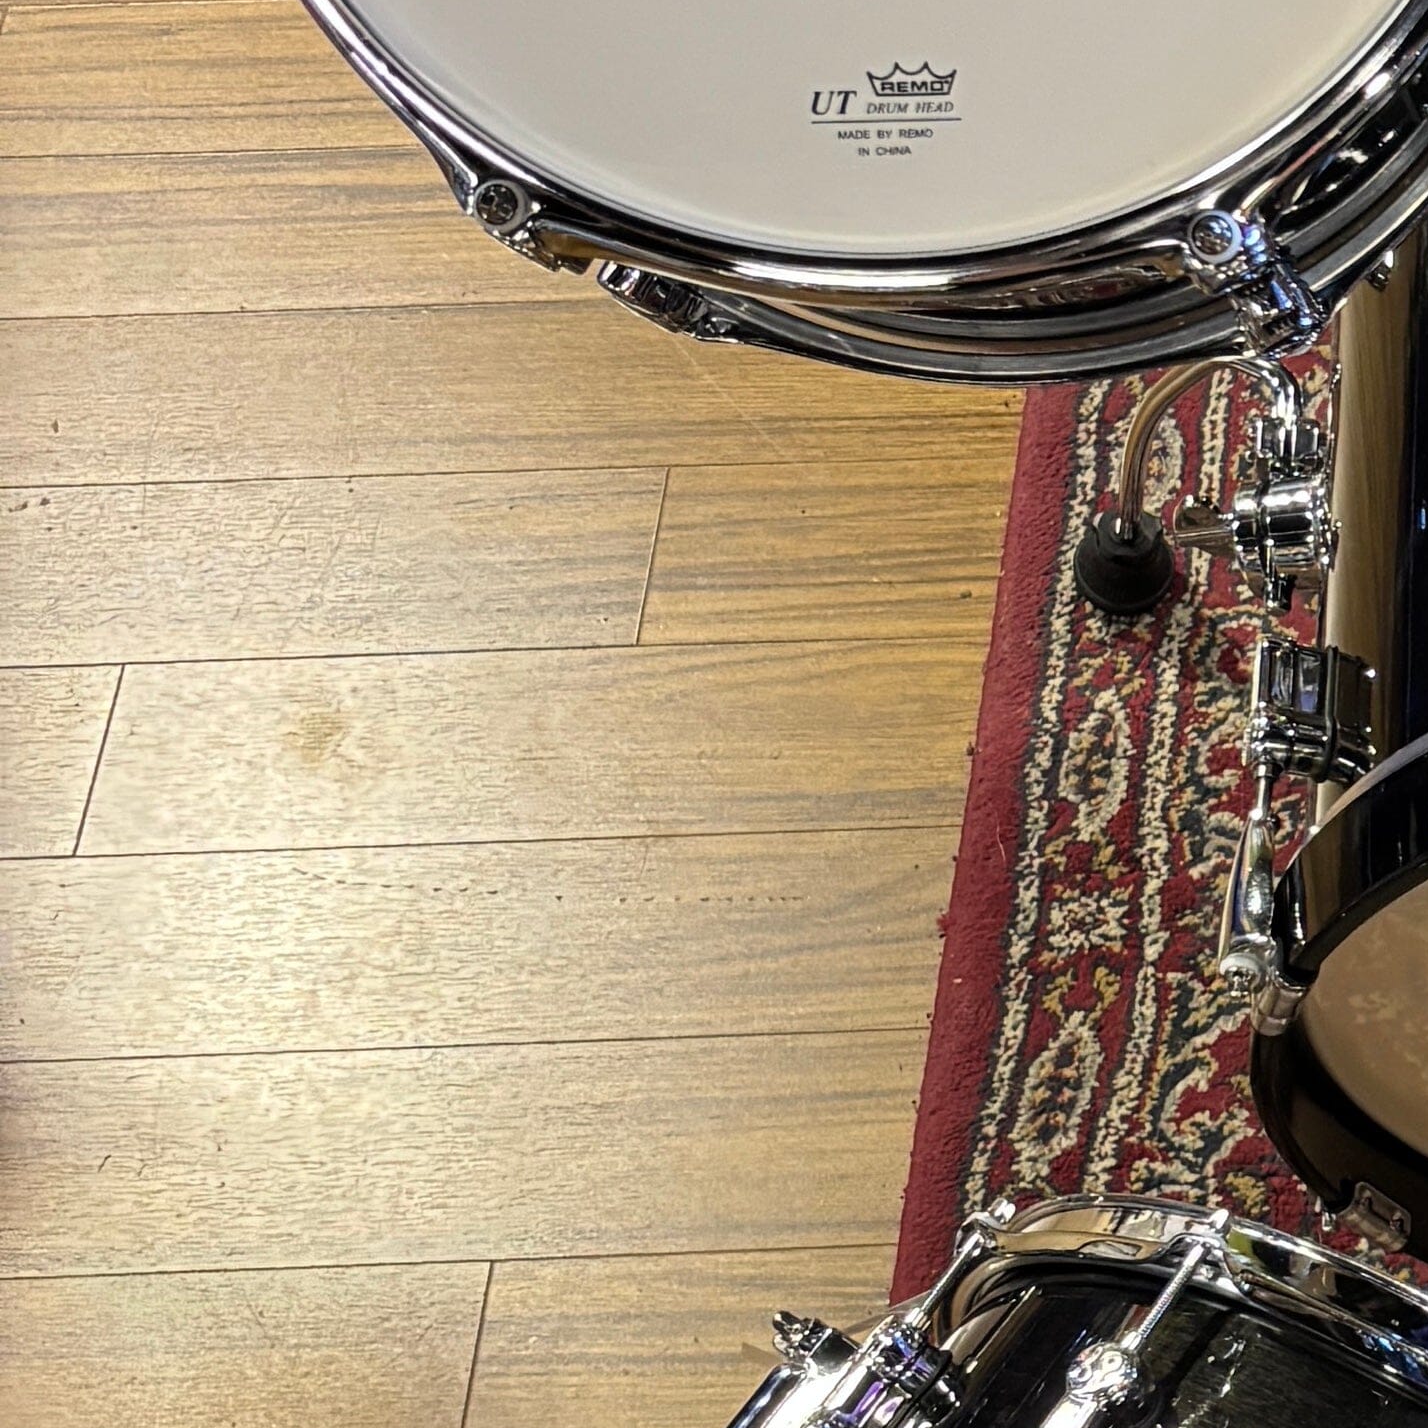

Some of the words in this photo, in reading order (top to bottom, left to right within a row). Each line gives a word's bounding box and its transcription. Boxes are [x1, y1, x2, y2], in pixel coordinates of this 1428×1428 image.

[880, 80, 945, 93] REMO
[811, 91, 857, 115] UT
[866, 102, 909, 114] DRUM
[915, 101, 954, 113] HEAD
[837, 130, 870, 140] MADE
[877, 130, 892, 139] BY
[899, 128, 933, 139] REMO
[858, 147, 870, 156] IN
[876, 146, 912, 156] CHINA
